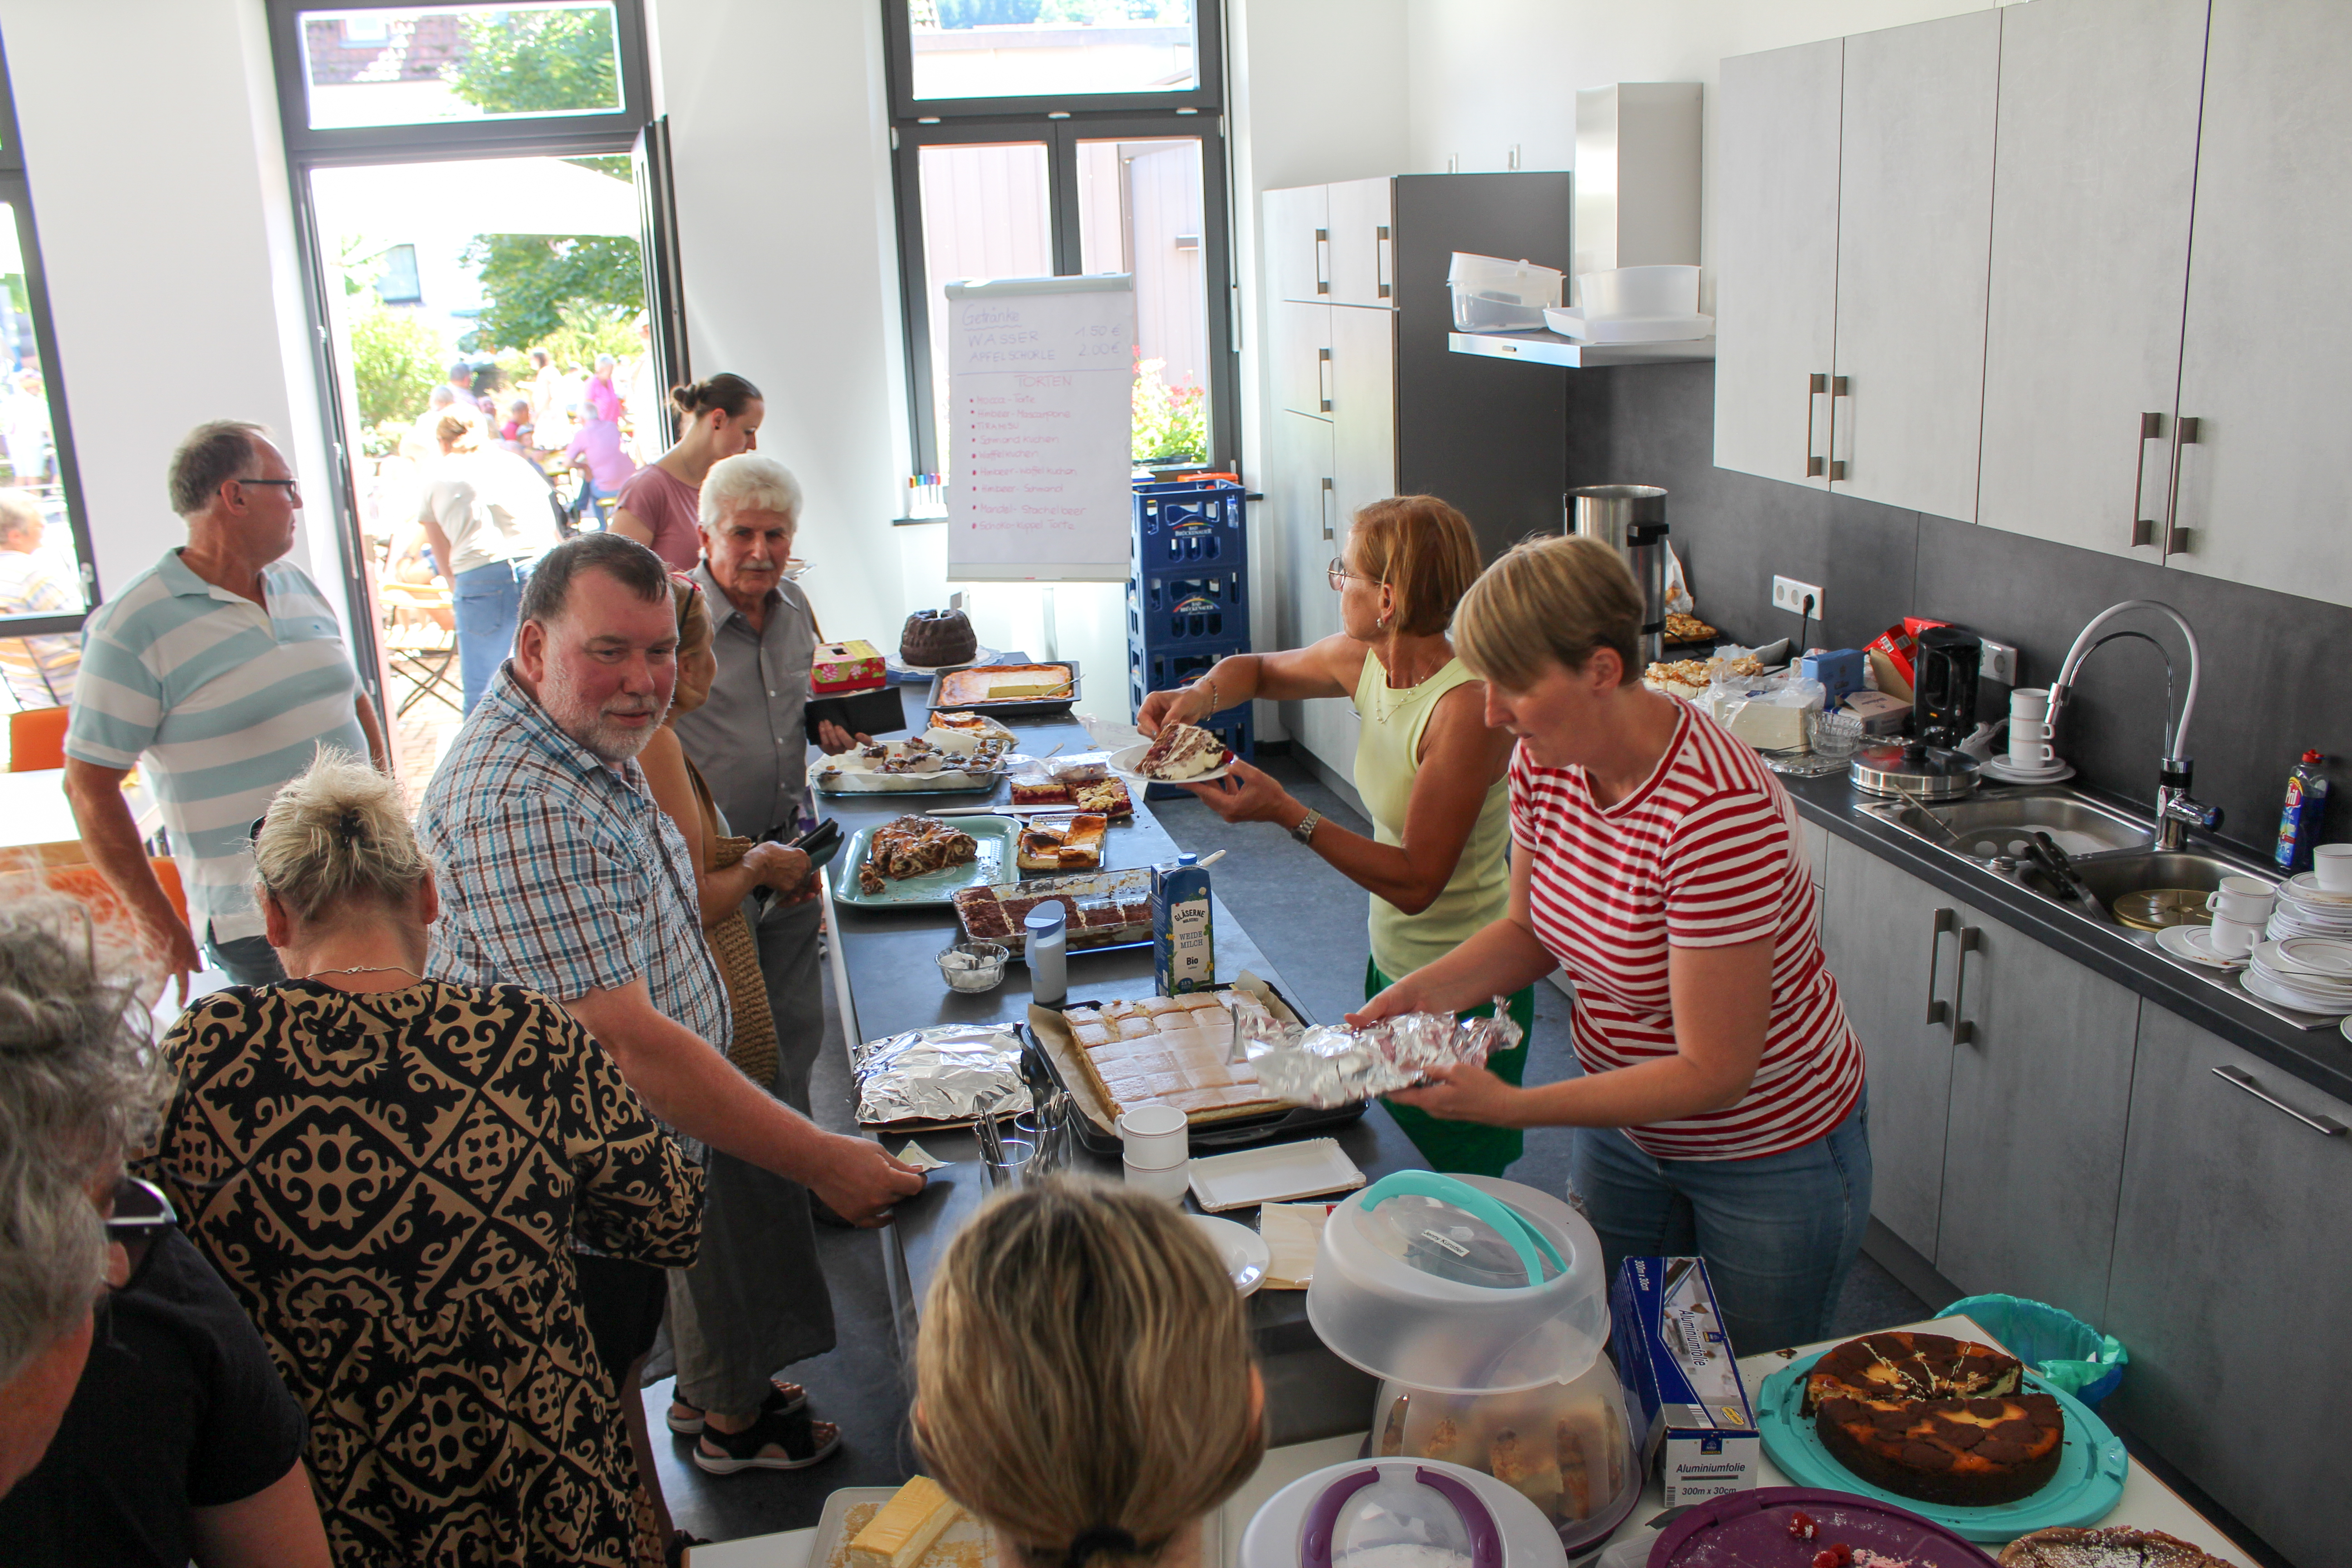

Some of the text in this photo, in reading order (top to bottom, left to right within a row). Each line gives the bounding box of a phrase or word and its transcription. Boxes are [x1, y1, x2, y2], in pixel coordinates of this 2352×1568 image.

[968, 330, 1039, 348] WASSER
[1074, 325, 1107, 337] 1.50
[1014, 374, 1073, 387] TORTEN
[1174, 909, 1205, 921] GLÄSERNE
[1179, 931, 1203, 941] WEIDE
[1181, 939, 1203, 949] MILCH
[1186, 956, 1198, 965] Bio
[1424, 1231, 1441, 1240] Jenny
[1634, 1260, 1646, 1274] 300m
[1639, 1278, 1649, 1291] 30cm
[1679, 1309, 1709, 1366] Aluminiumfolie
[1676, 1462, 1746, 1473] Aluminiumfolie
[1682, 1487, 1705, 1495] 300m
[1713, 1486, 1737, 1494] 30cm
